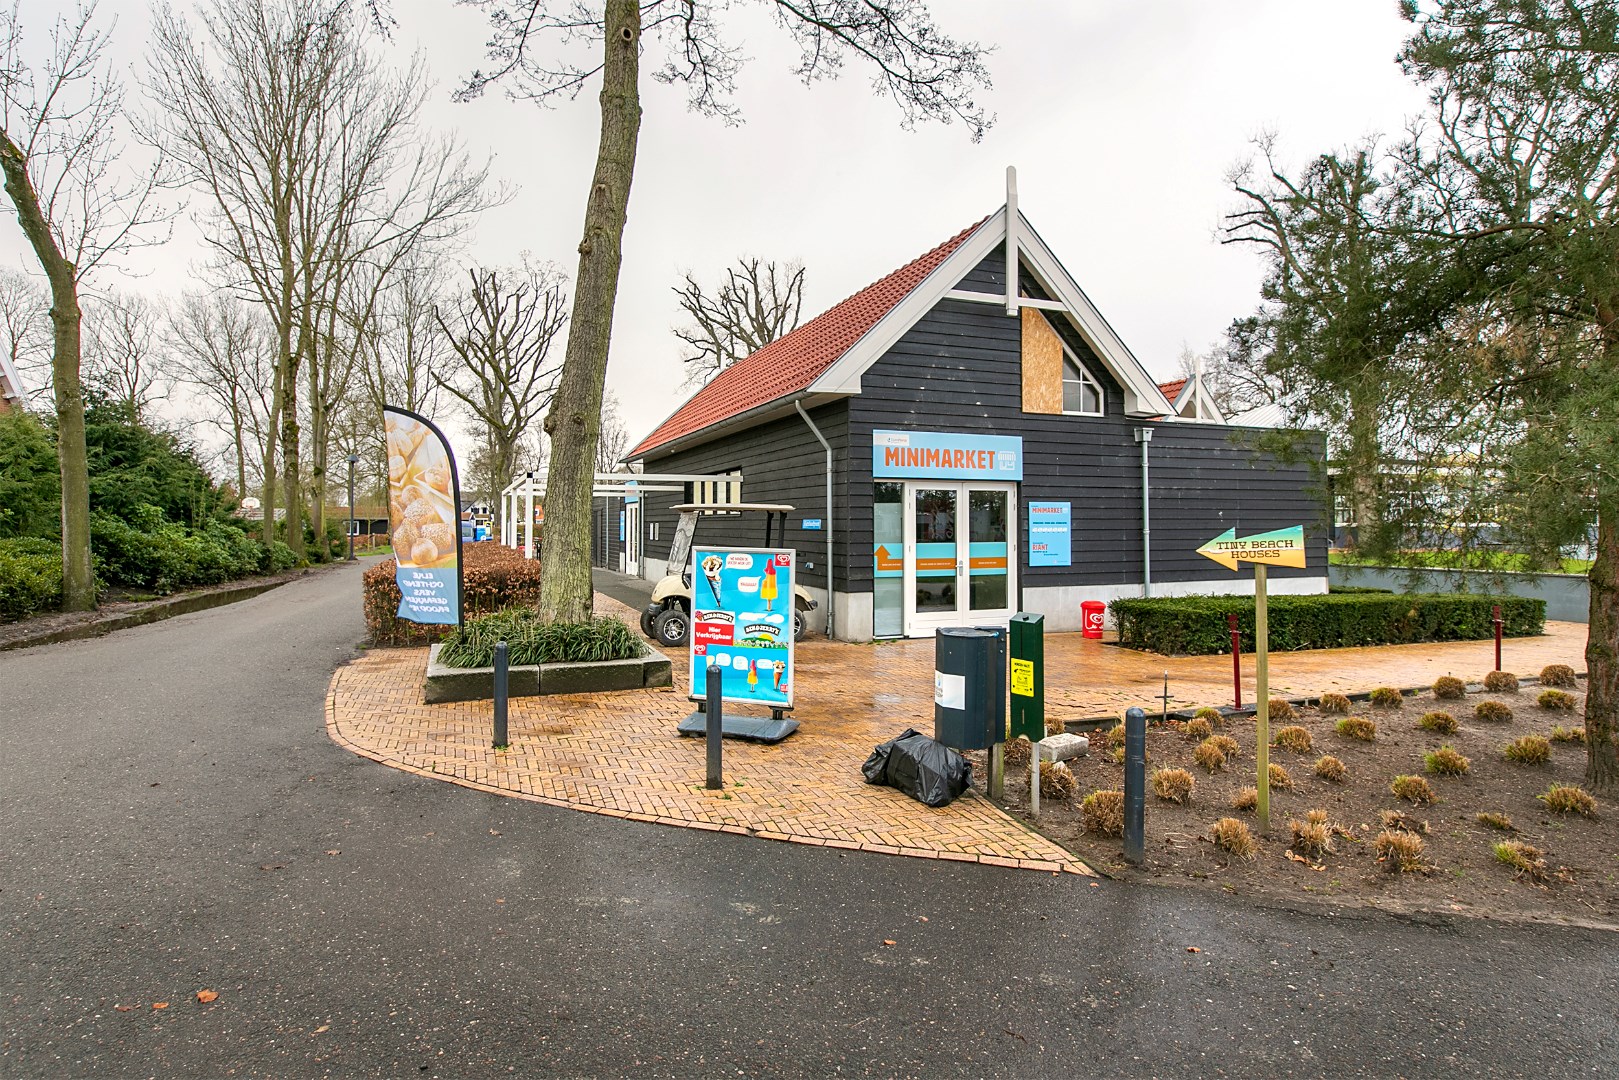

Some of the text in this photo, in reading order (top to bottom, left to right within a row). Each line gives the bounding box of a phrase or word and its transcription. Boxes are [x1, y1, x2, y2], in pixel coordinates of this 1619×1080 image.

[885, 446, 996, 470] MINIMARKET
[1216, 539, 1294, 550] TINY BEACH
[1231, 550, 1280, 559] HOUSES
[695, 632, 732, 640] Verkrijgbaar
